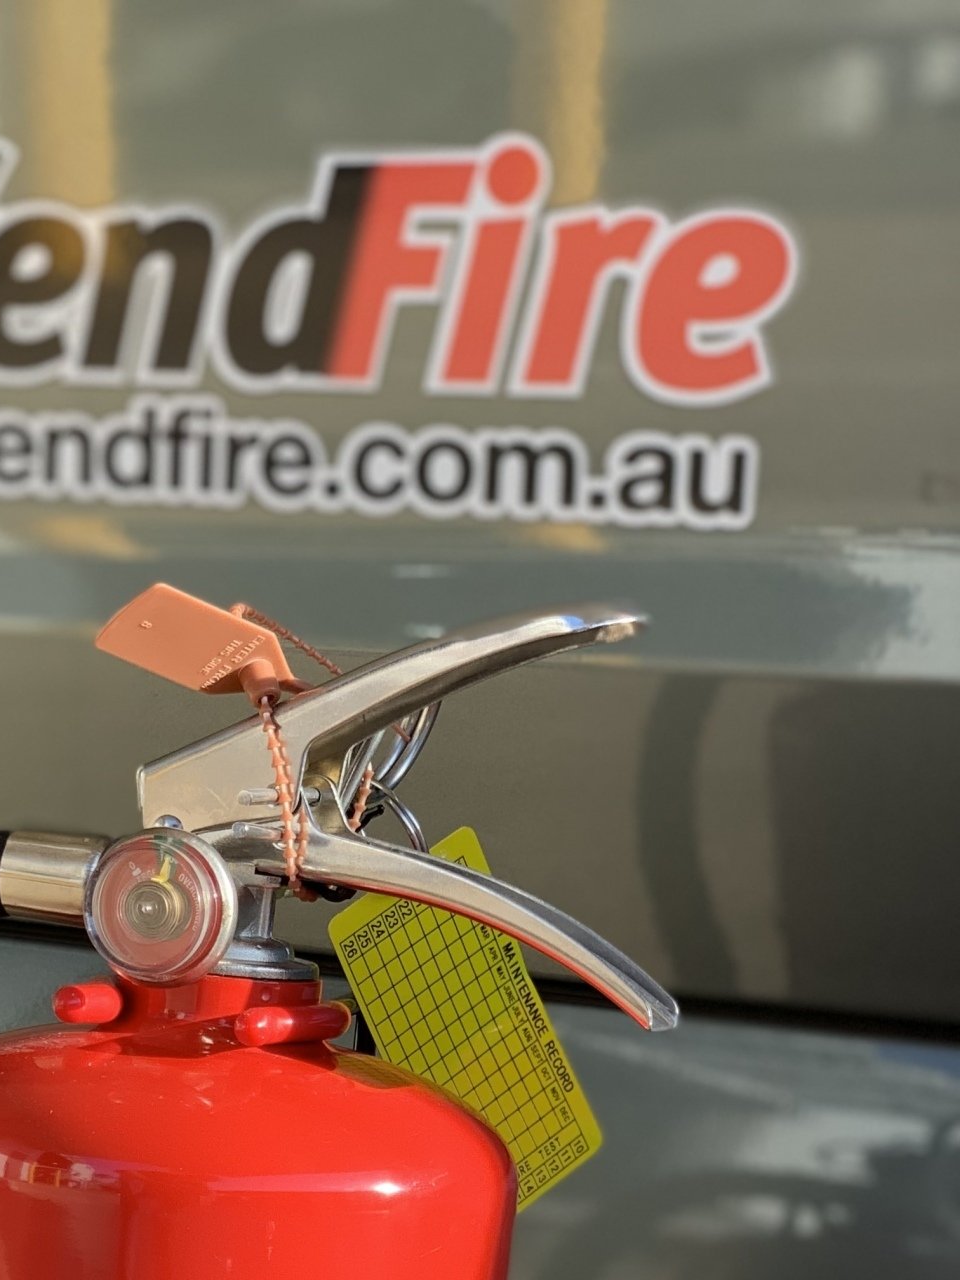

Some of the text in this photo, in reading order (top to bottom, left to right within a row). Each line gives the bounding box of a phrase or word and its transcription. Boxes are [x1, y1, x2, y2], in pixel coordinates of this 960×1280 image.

[398, 901, 413, 920] 22
[385, 911, 399, 929] 23
[371, 921, 385, 939] 24
[357, 930, 372, 949] 25
[343, 940, 358, 959] 26
[502, 942, 574, 1093] MAINTENANCE RECORD
[496, 966, 506, 981] MAY
[522, 1028, 534, 1043] AUG
[551, 1087, 561, 1101] NOV
[538, 1136, 561, 1160] TEST
[573, 1139, 585, 1154] 10
[561, 1149, 572, 1163] 11
[548, 1159, 560, 1174] 12
[535, 1169, 547, 1183] 13
[523, 1179, 534, 1193] 14
